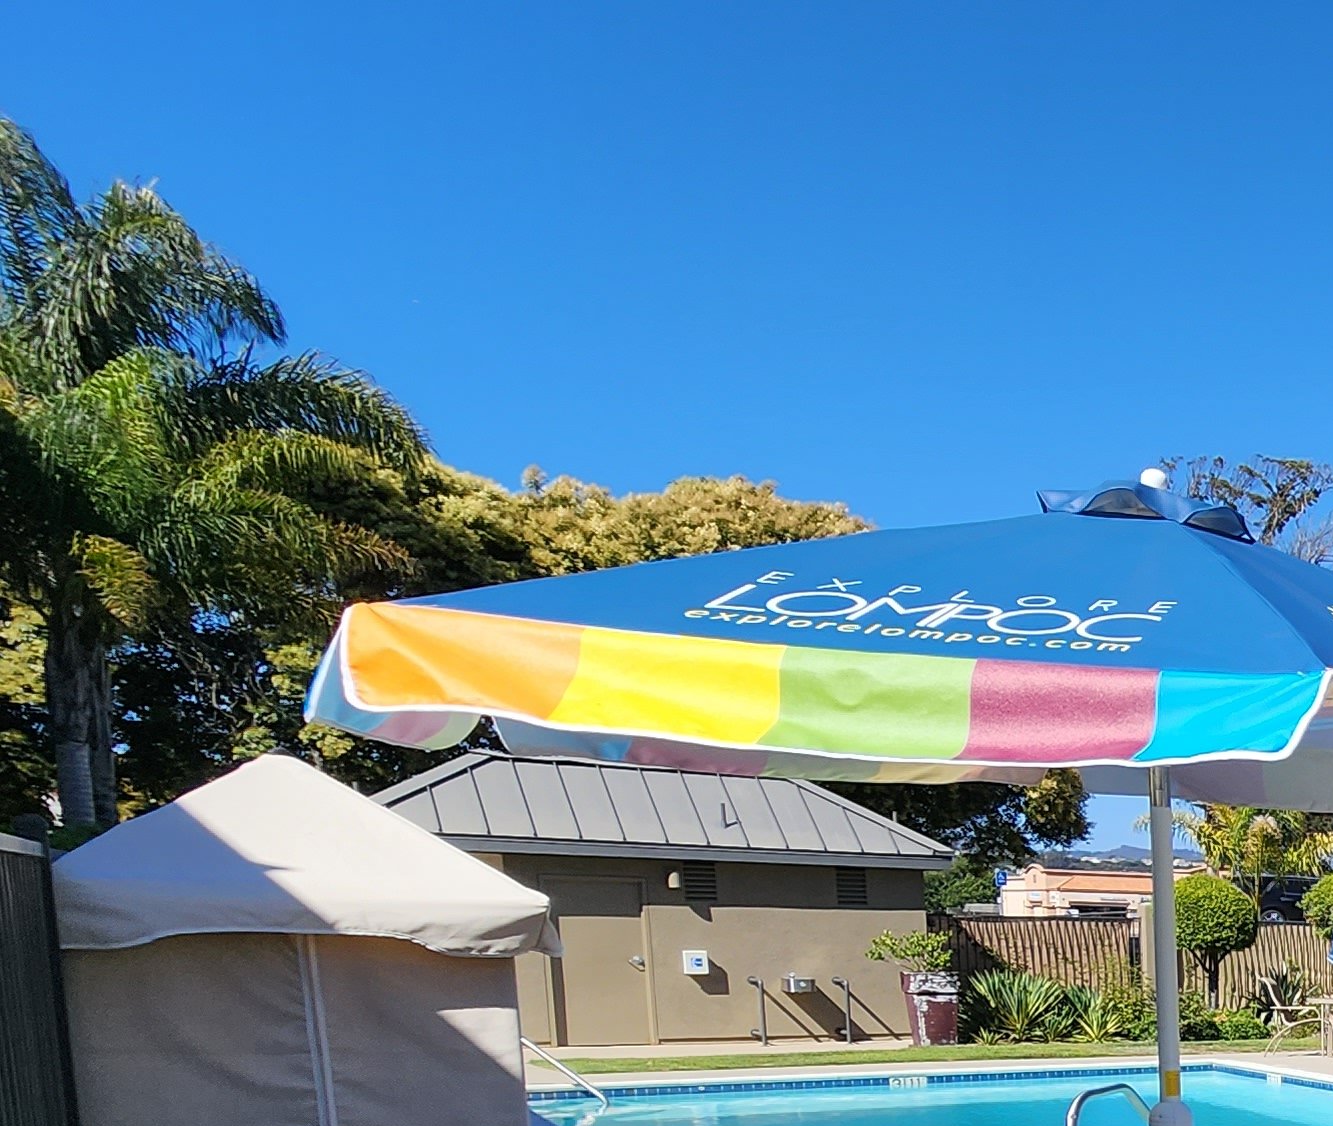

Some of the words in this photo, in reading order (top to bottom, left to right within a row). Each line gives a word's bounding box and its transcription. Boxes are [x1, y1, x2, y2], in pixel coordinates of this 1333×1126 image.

[704, 584, 1162, 642] LOMPOC
[757, 571, 1178, 613] EXPLORE
[684, 609, 1132, 652] explorelompoc.com
